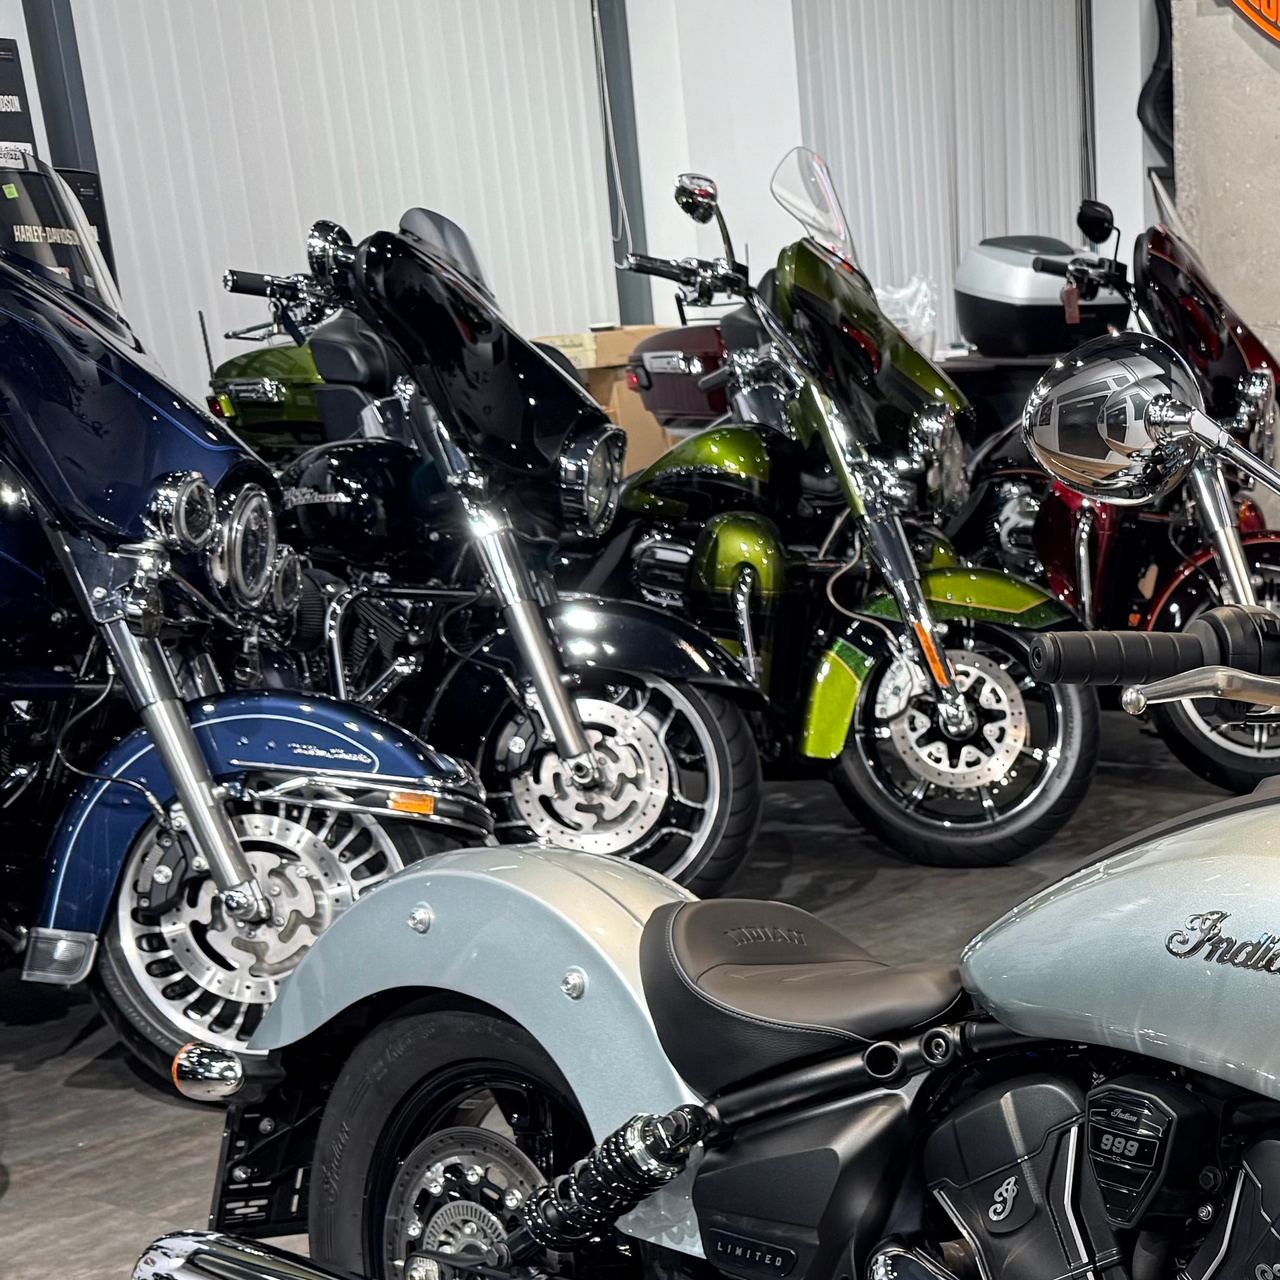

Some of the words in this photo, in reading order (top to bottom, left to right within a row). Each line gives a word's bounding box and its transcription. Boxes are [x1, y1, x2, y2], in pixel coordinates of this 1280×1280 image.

[723, 926, 807, 947] INDIAN
[1110, 1108, 1138, 1122] Indian
[1100, 1133, 1140, 1157] 999
[716, 1241, 783, 1267] LIMITED
